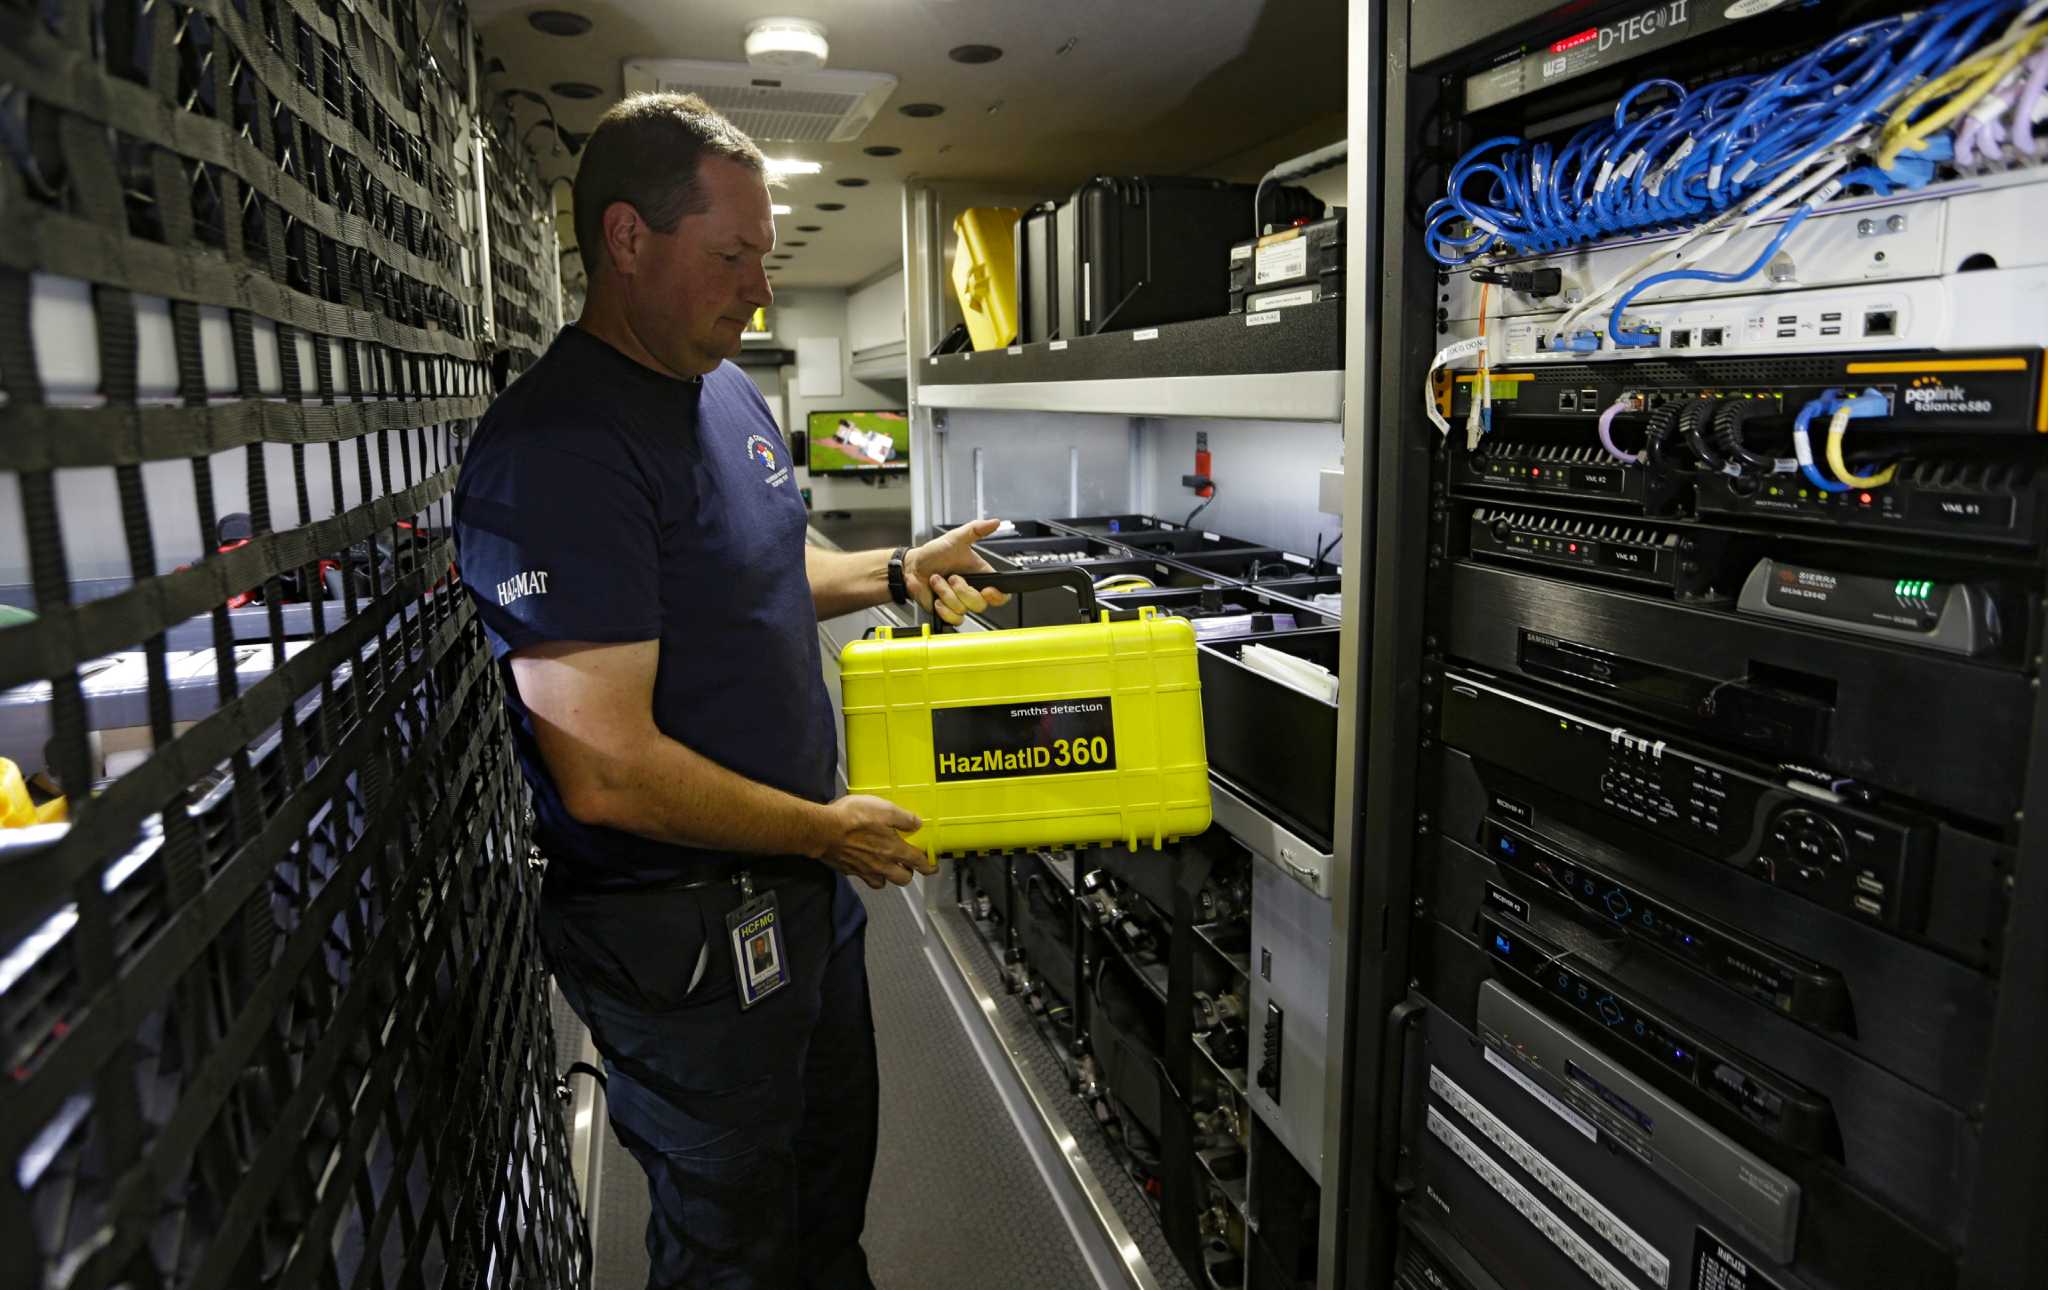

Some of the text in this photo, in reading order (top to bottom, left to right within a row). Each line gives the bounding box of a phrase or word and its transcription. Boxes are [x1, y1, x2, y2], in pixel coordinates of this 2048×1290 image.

[1905, 386, 1965, 404] peplink
[1799, 572, 1837, 585] SIERRA
[1011, 703, 1103, 717] smiths detection
[939, 736, 1108, 774] HazMatID 360
[741, 912, 775, 938] HCFMO
